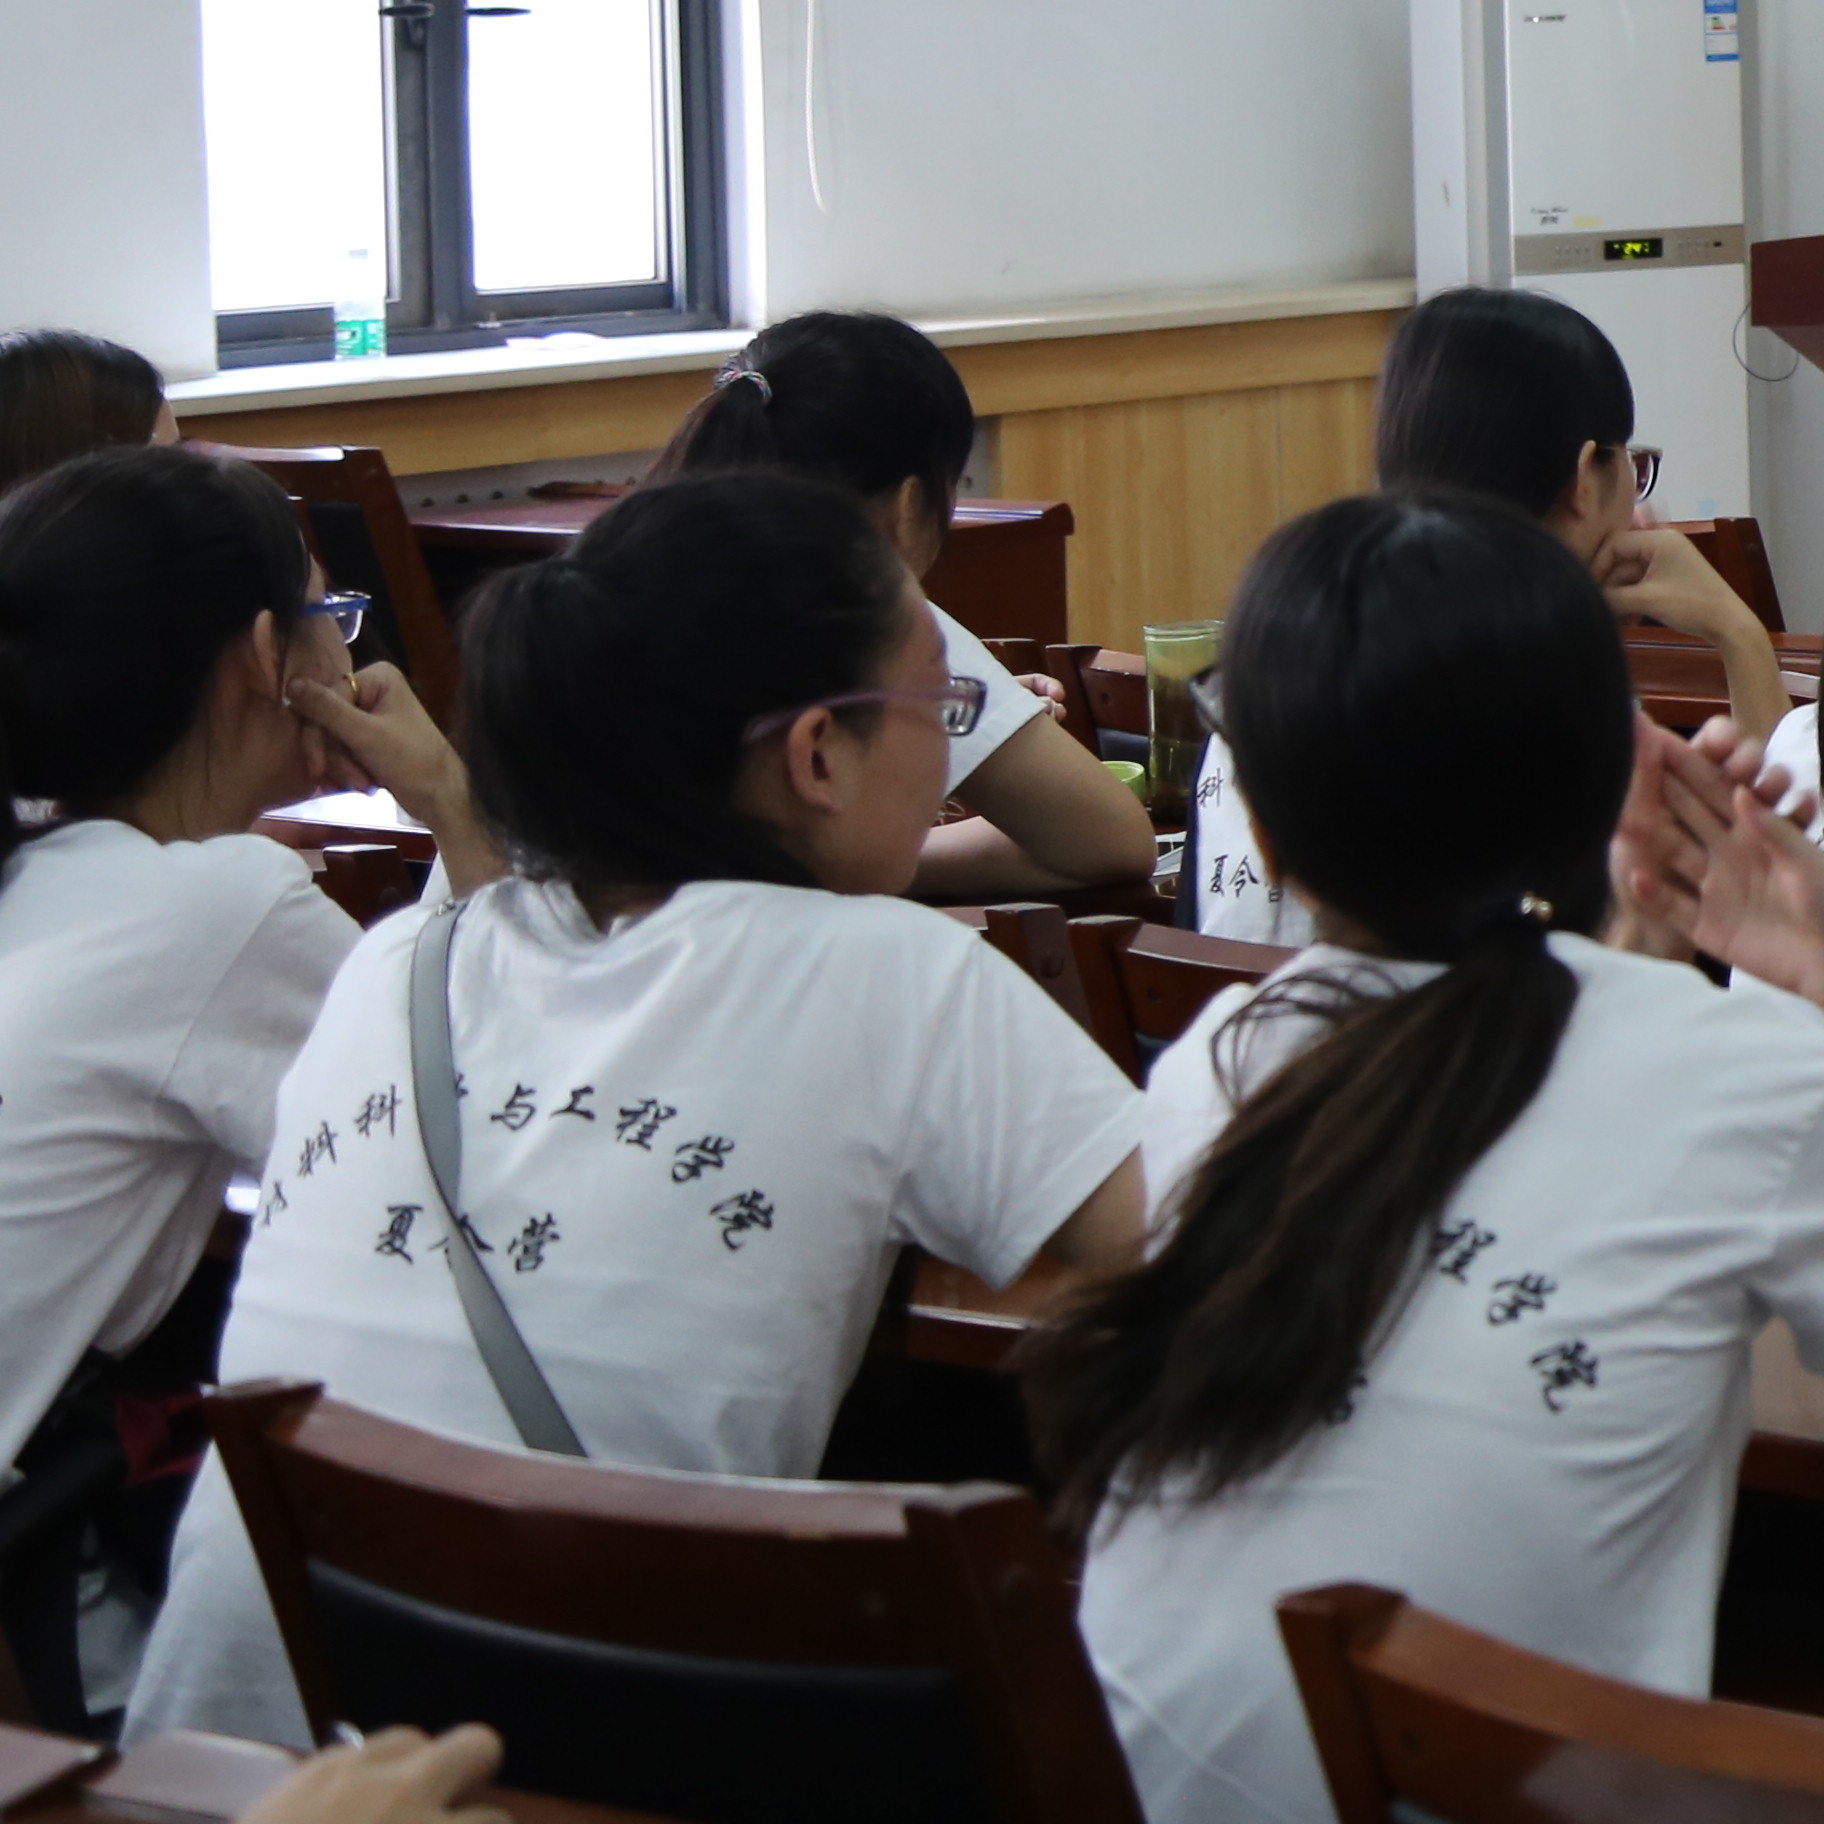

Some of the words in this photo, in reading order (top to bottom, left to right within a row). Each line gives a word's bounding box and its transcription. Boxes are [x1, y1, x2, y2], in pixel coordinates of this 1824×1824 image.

[263, 1073, 776, 1251] 材料科与工程学院
